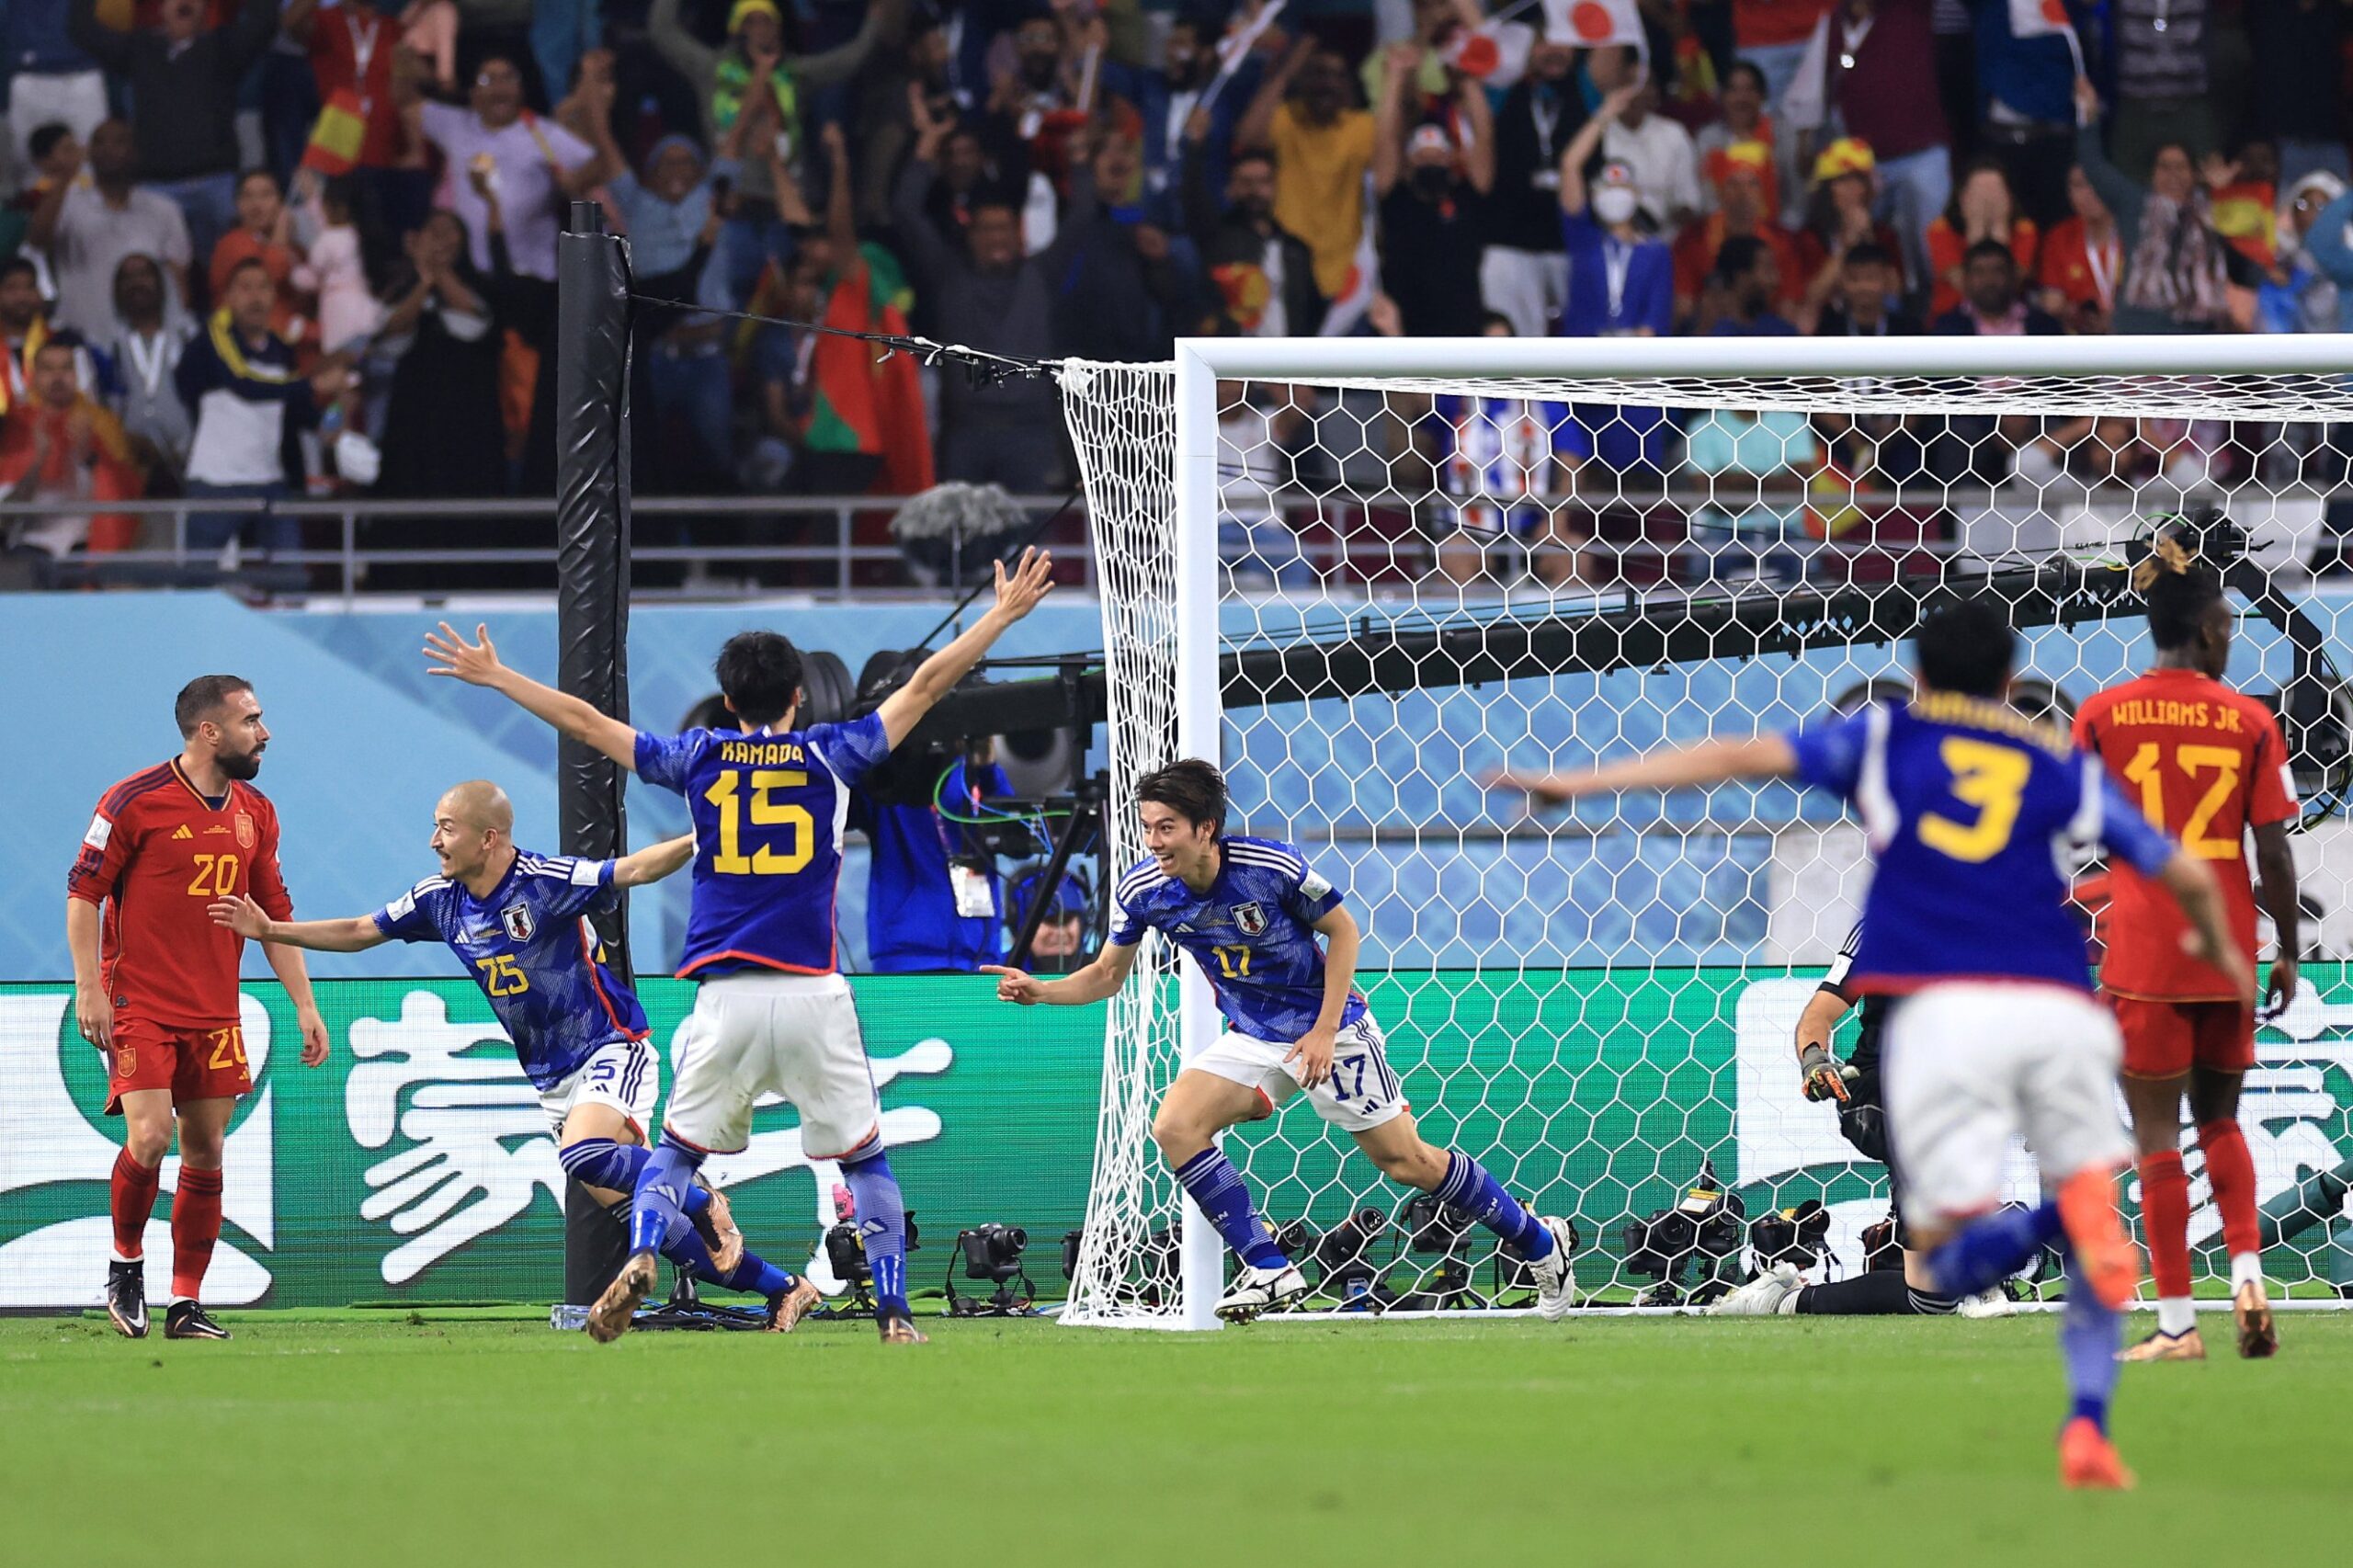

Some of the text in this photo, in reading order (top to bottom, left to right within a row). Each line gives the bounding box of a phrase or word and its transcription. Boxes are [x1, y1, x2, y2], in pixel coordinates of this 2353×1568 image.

[2111, 699, 2244, 733] WILLIAMS JR.
[721, 741, 804, 766] KAMADA
[1915, 734, 2031, 865] 3
[2123, 743, 2241, 859] 12
[704, 769, 814, 875] 15
[188, 853, 239, 896] 20
[476, 953, 530, 996] 25
[1211, 944, 1251, 979] 17
[583, 1058, 618, 1084] 5
